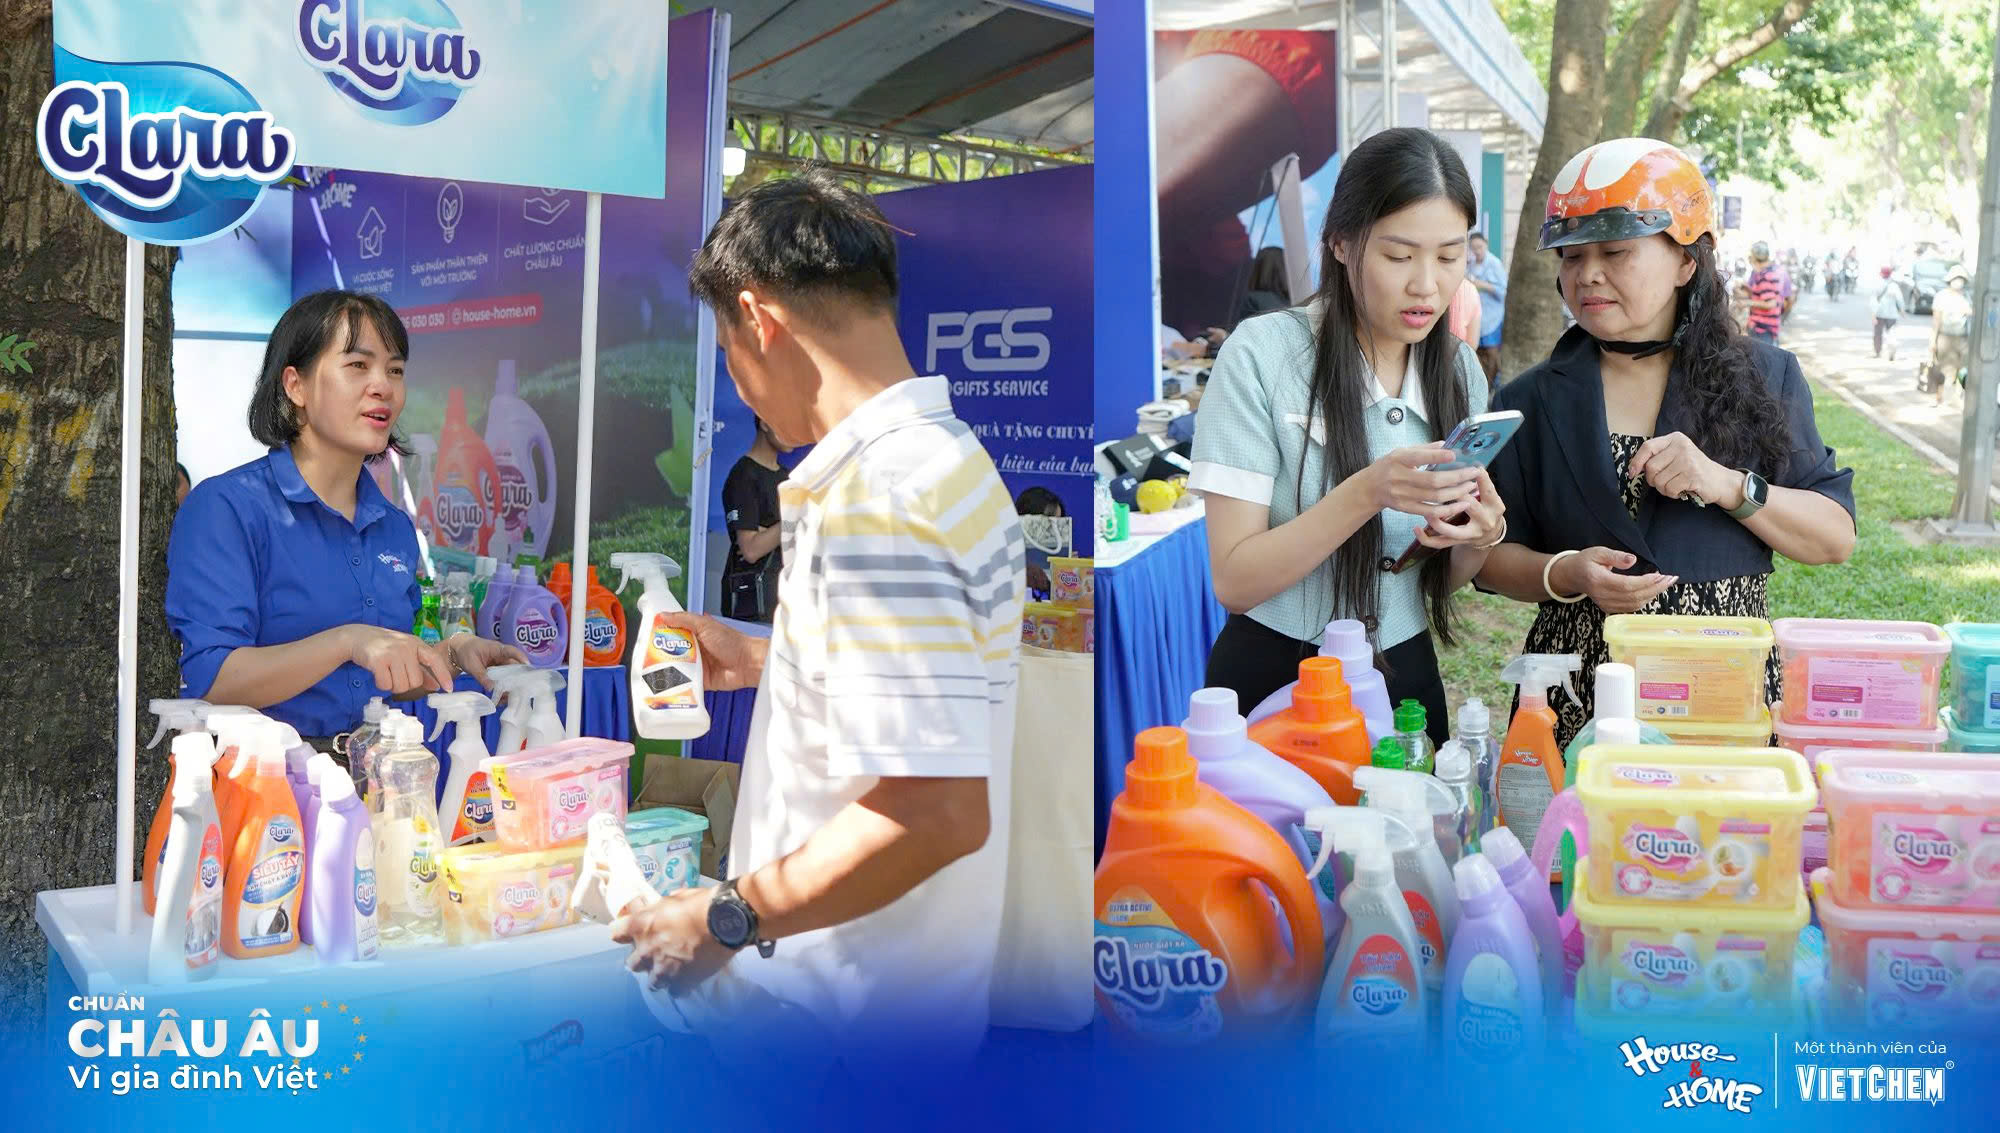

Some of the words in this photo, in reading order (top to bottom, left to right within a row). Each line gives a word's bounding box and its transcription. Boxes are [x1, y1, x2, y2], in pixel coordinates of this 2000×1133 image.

[299, 0, 481, 91] Clara
[503, 242, 524, 259] CHẤT
[524, 256, 548, 271] CHÂU
[549, 254, 563, 268] ÂU
[926, 306, 1053, 373] PGS
[992, 380, 1049, 396] SERVICE
[973, 421, 1000, 439] QUÀ
[1004, 422, 1043, 441] TẶNG
[1001, 453, 1035, 474] hiệu
[1038, 454, 1066, 472] của
[516, 623, 557, 647] Clara
[653, 636, 692, 653] Clara
[560, 791, 589, 809] Clara
[1635, 833, 1698, 860] Clara
[1894, 834, 1958, 861] Clara
[1094, 939, 1223, 1005] Clara
[1634, 950, 1695, 976] Clara
[1889, 960, 1953, 988] Clara
[1352, 984, 1408, 1008] Clara
